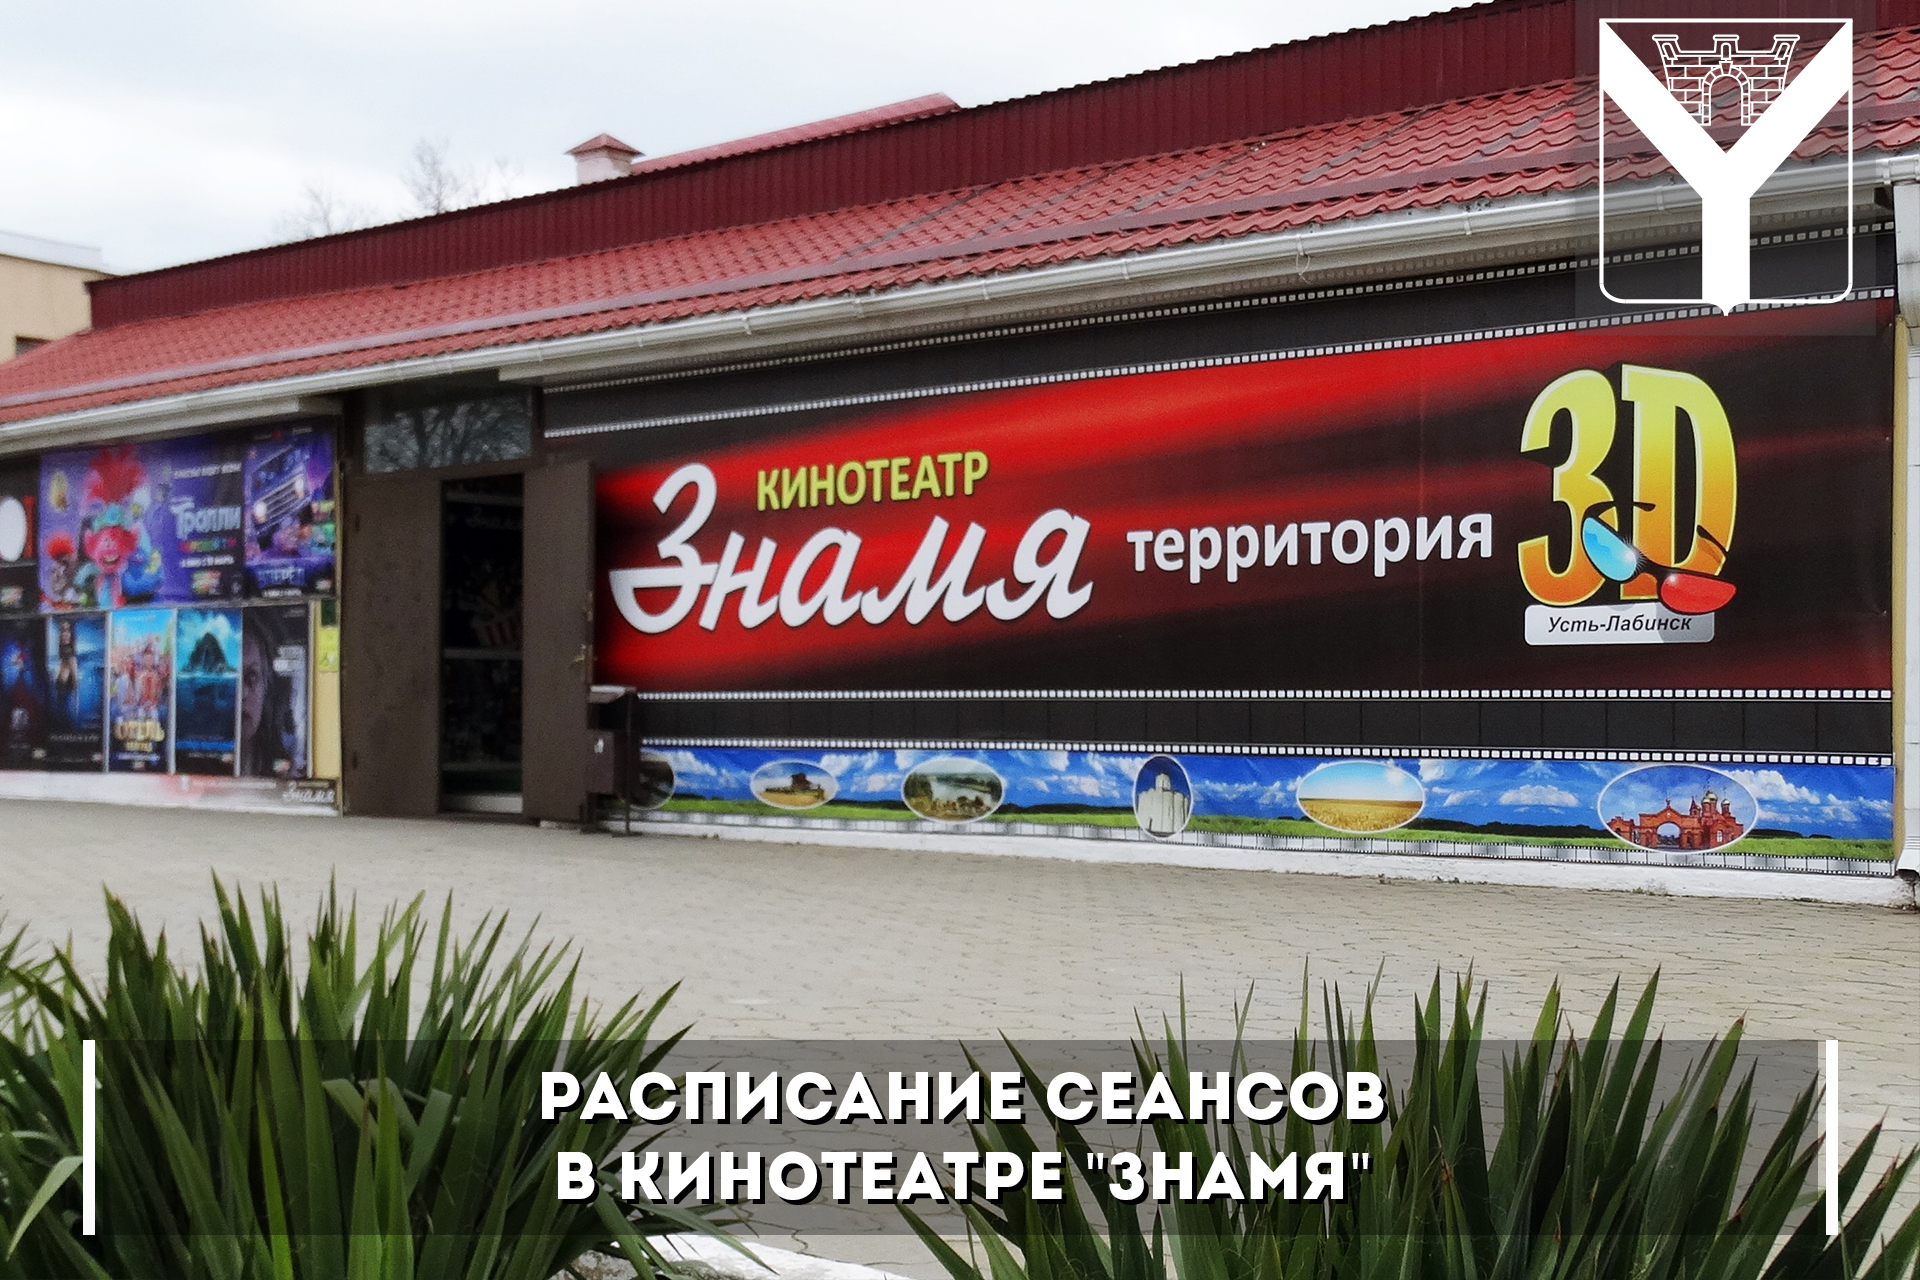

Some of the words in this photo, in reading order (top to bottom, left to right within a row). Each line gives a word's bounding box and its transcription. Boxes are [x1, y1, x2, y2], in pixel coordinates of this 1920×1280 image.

[756, 450, 990, 512] КИНОТЕАТР
[1126, 513, 1494, 584] территория
[1517, 363, 1738, 606] 3D
[608, 462, 1095, 634] Знамя
[1548, 615, 1693, 633] Усть-Лабинск
